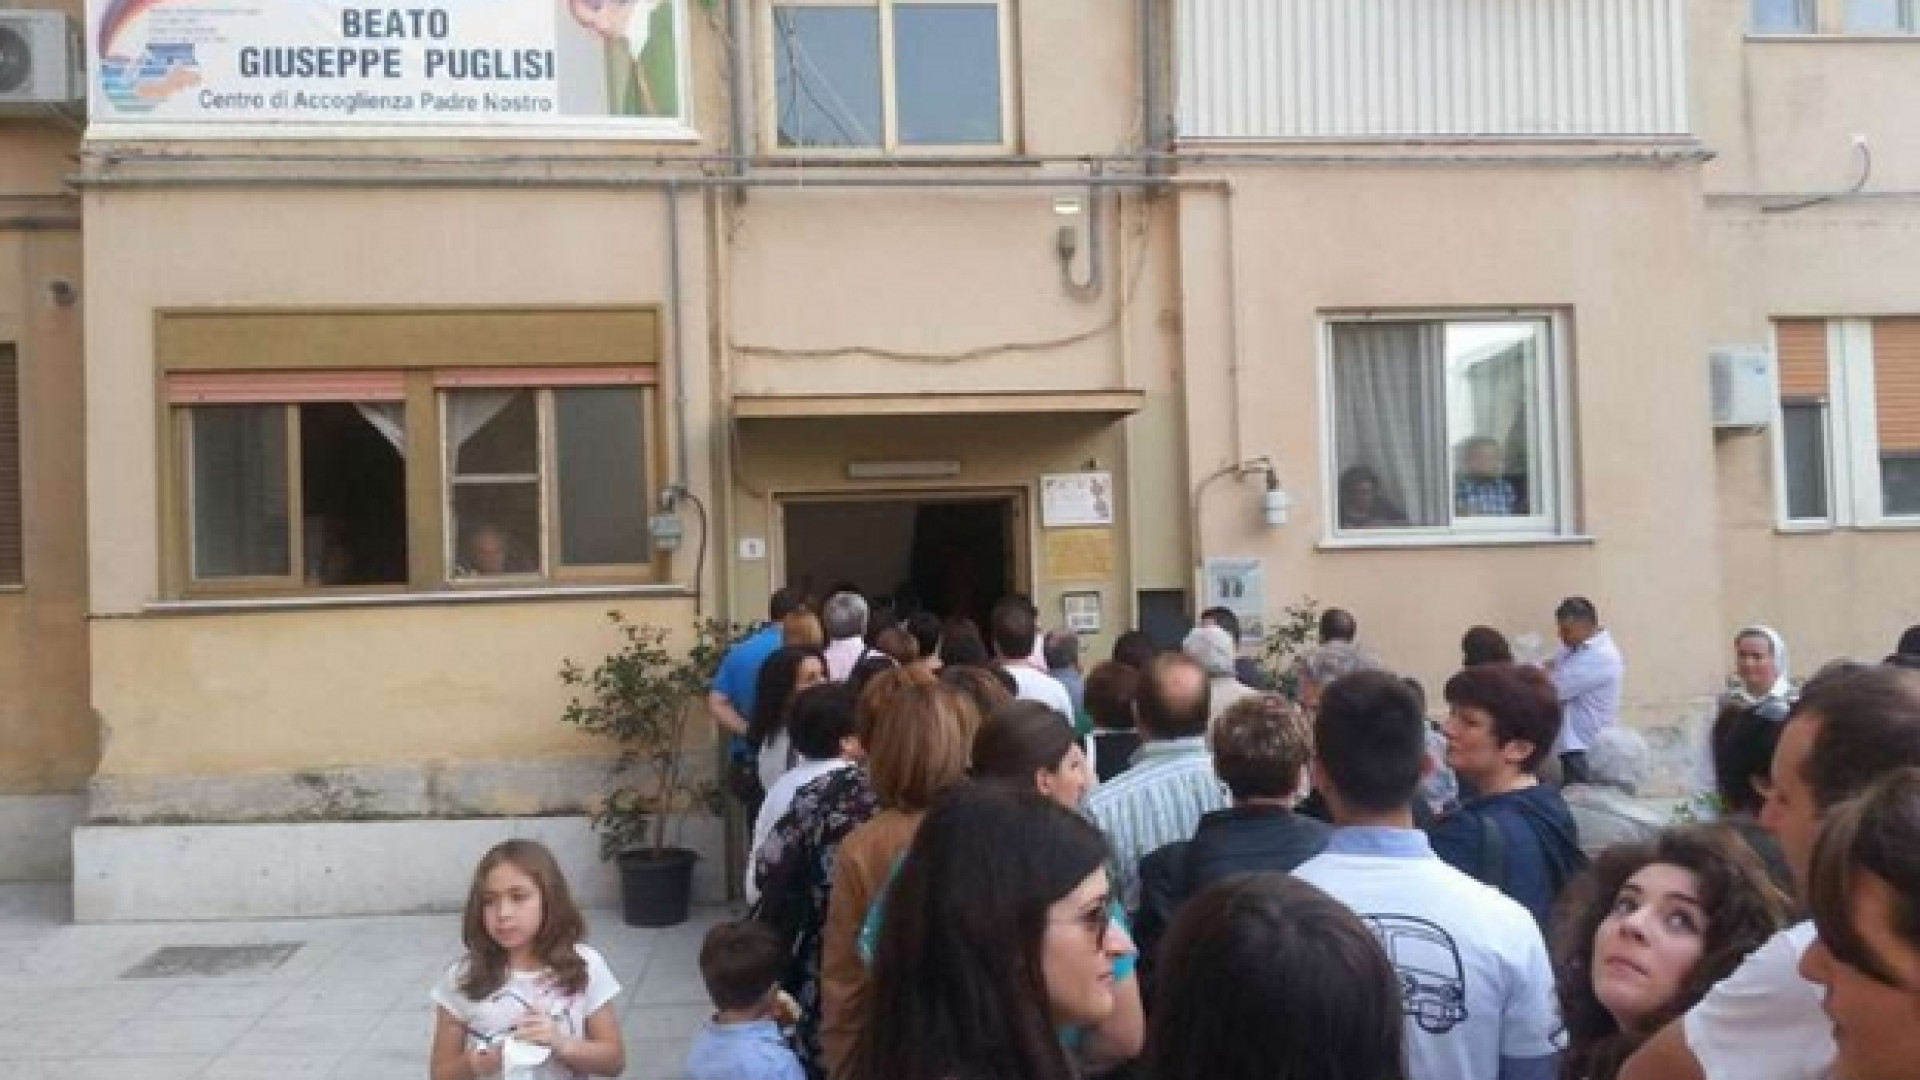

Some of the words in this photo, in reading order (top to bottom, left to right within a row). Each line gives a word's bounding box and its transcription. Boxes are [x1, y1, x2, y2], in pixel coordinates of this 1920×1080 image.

[342, 8, 449, 39] BEATO
[239, 47, 403, 79] GIUSEPPE
[423, 48, 556, 81] PUGLISI
[199, 89, 264, 110] Centro
[270, 90, 289, 110] di
[294, 91, 415, 115] Accoglienza
[420, 92, 478, 112] Padre
[483, 92, 553, 113] Nostro
